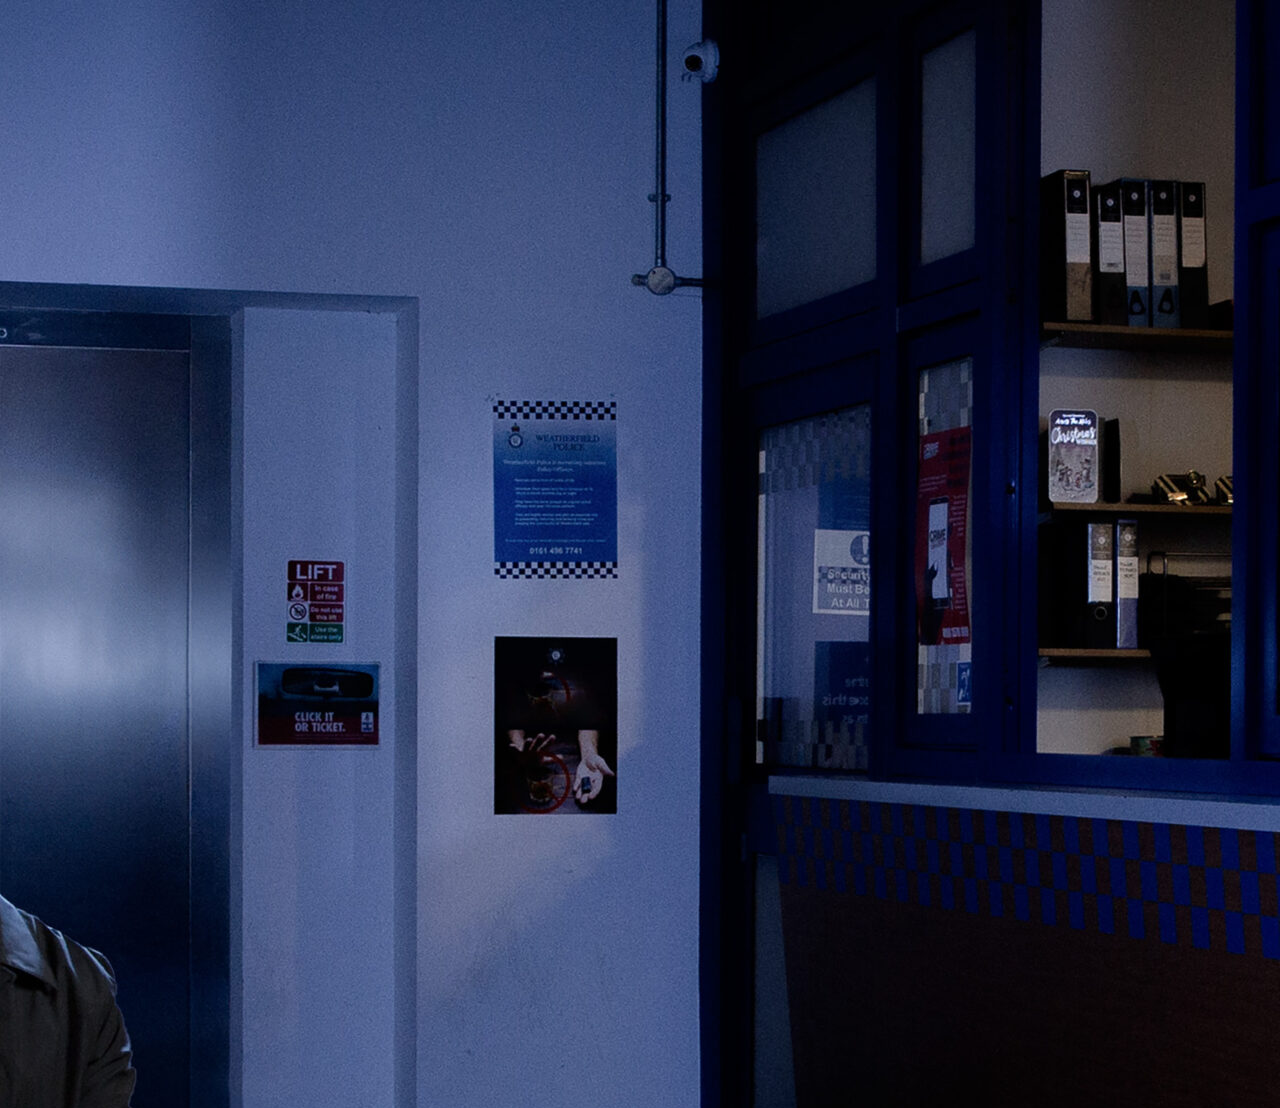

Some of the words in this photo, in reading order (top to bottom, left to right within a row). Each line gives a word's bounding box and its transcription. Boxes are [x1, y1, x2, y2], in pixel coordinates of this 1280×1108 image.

[535, 434, 600, 443] WEATHERFIELD
[553, 443, 585, 451] POLICE
[296, 564, 337, 580] LIFT
[827, 583, 853, 594] Must
[831, 597, 844, 608] At
[846, 597, 859, 608] All
[294, 711, 322, 722] CLICK
[325, 711, 335, 722] IT
[295, 722, 309, 732] OR
[311, 722, 347, 733] TICKET.
